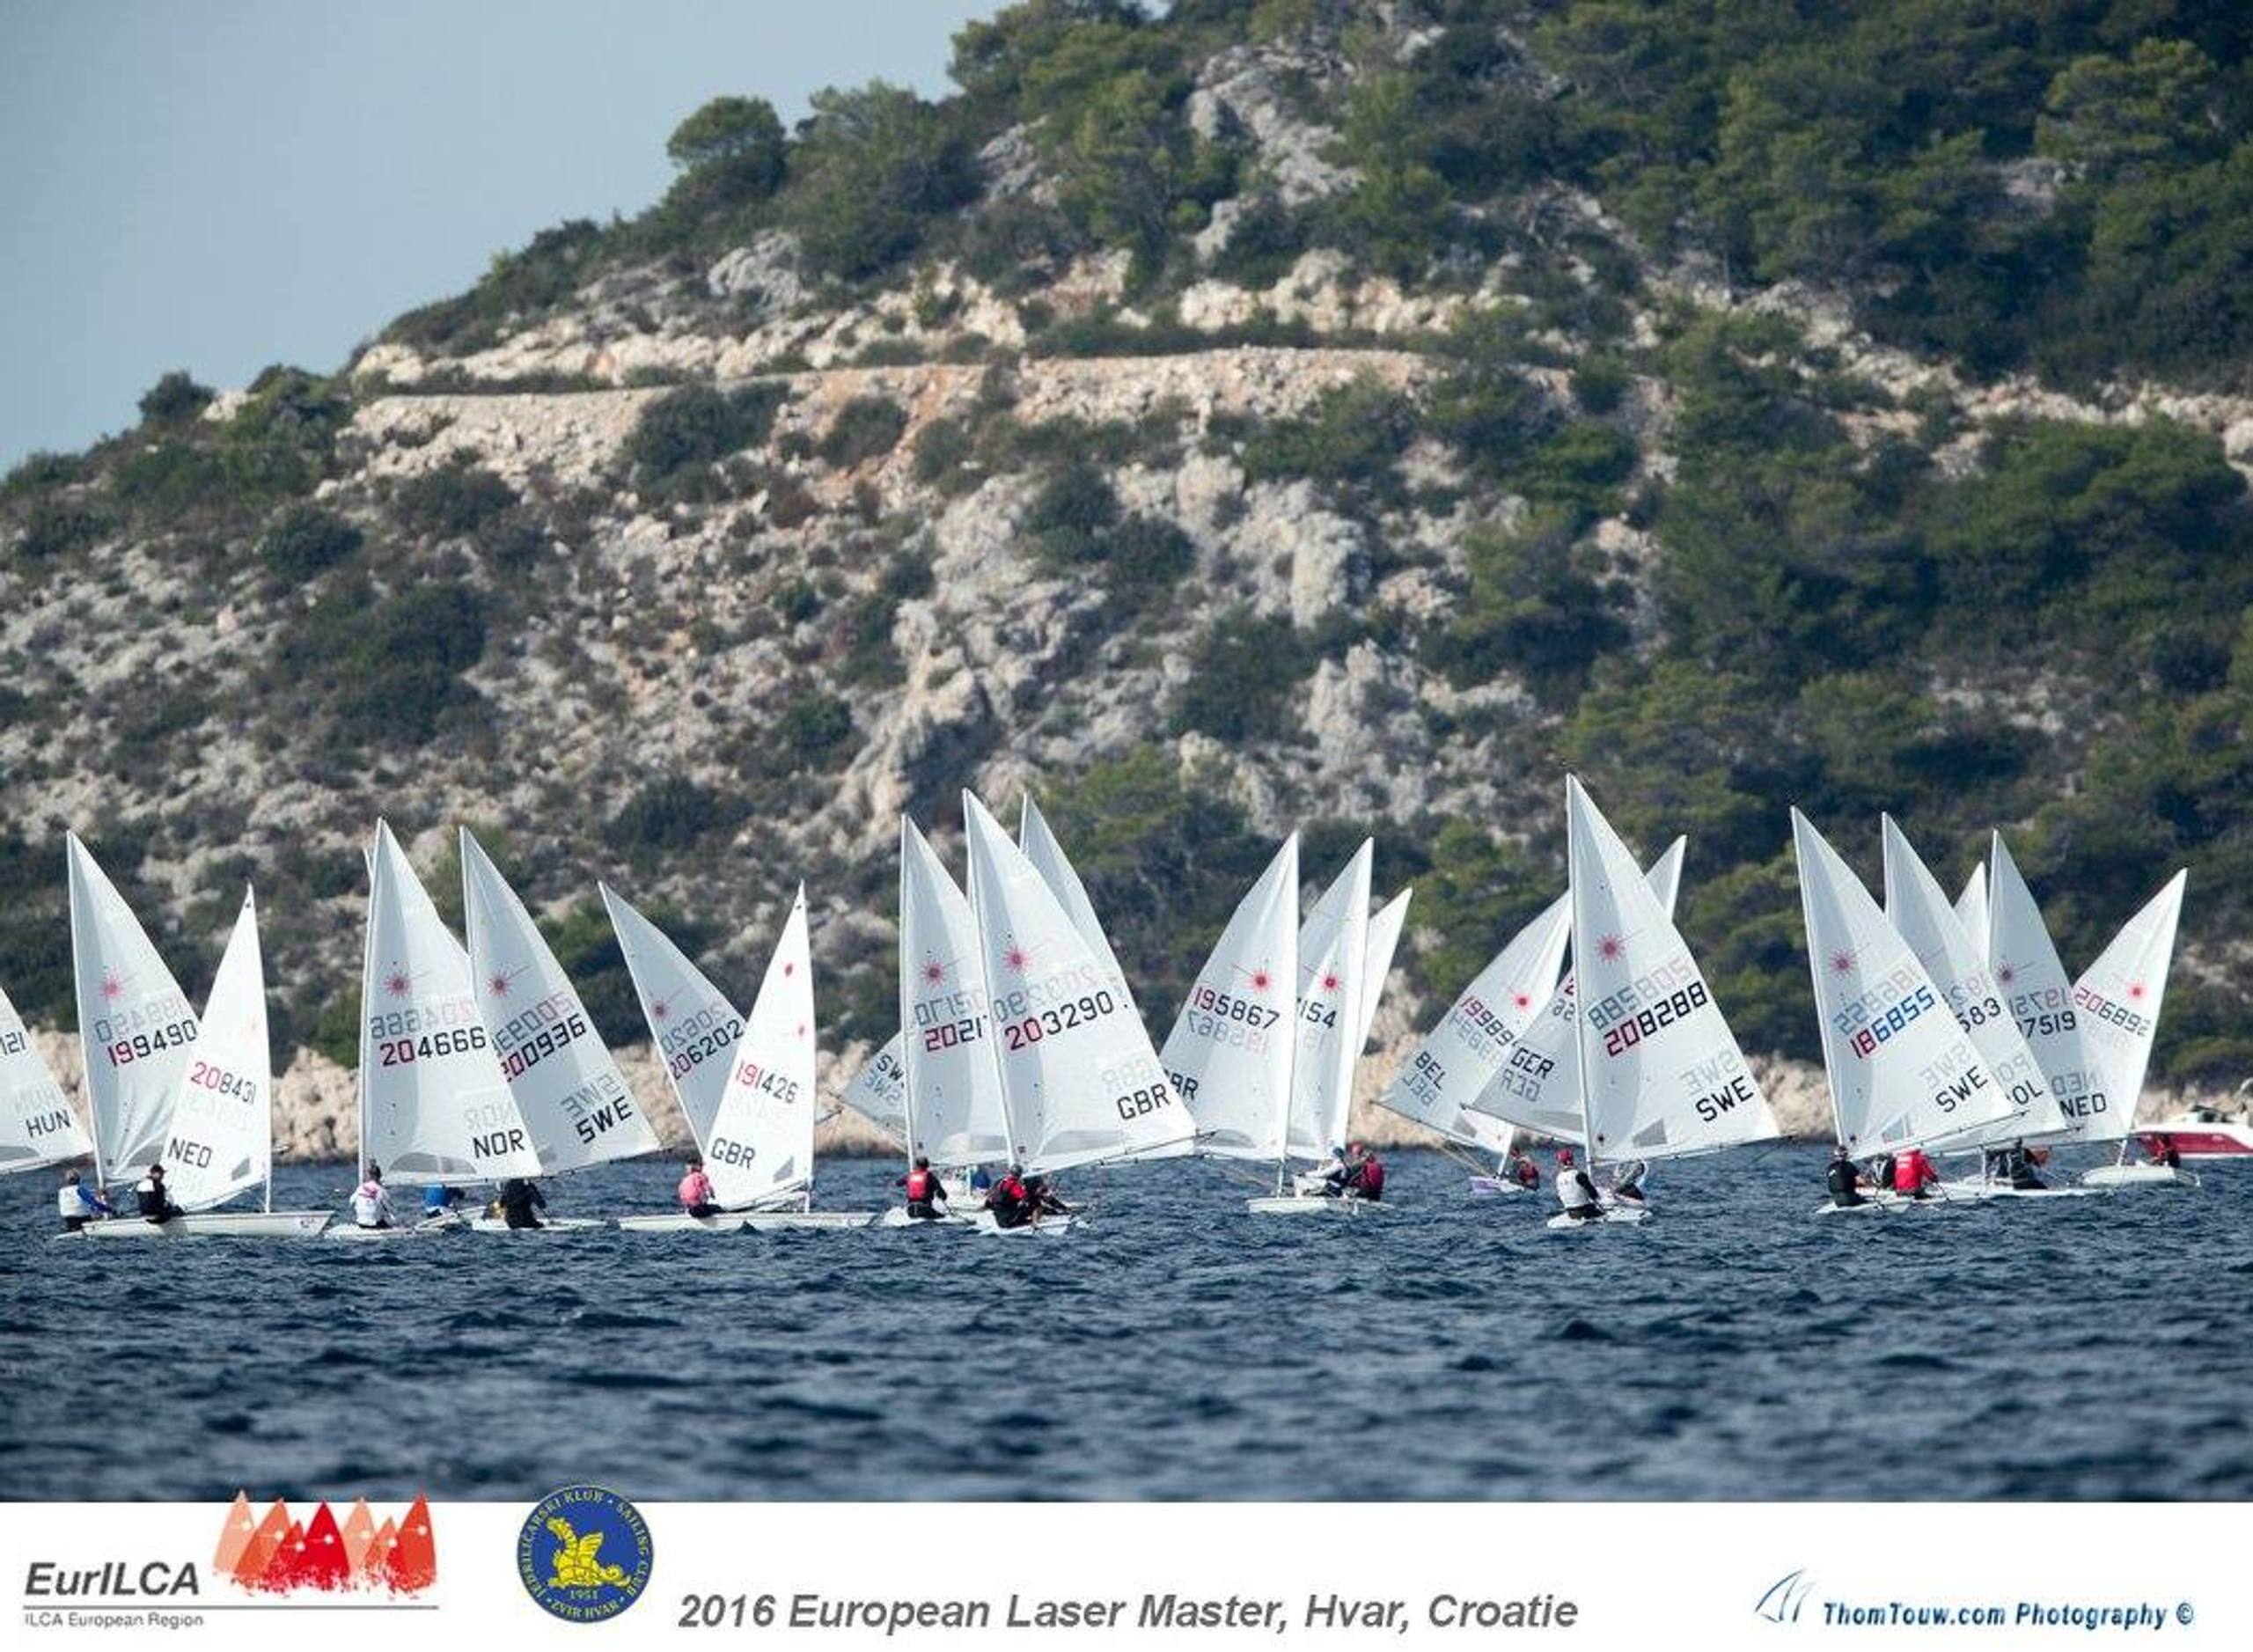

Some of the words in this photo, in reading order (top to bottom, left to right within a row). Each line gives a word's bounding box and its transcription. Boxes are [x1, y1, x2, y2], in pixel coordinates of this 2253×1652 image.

[1004, 990, 1114, 1051] 203290
[1193, 986, 1281, 1030] 195867
[1297, 997, 1337, 1029] 154
[1460, 995, 1519, 1047] 19989
[1603, 980, 1708, 1057] 208288
[1850, 985, 1935, 1060] 186855
[1941, 994, 2000, 1033] 583
[106, 1018, 198, 1068] 199490
[379, 1025, 487, 1068] 204666
[670, 1019, 745, 1081] 206202
[925, 1015, 987, 1052] 2021
[190, 1061, 257, 1105] 208431
[736, 1060, 799, 1104] 191426
[877, 1054, 905, 1089] SW
[1414, 1051, 1446, 1090] BEL
[1510, 1047, 1555, 1080] GER
[1116, 1083, 1171, 1120] GBR
[1163, 1068, 1198, 1100] BR
[1695, 1076, 1755, 1122] SWE
[1935, 1065, 1989, 1113] SWE
[2007, 1079, 2044, 1106] OL
[26, 1109, 71, 1138] HUN
[575, 1095, 633, 1144] SWE
[2059, 1092, 2106, 1119] NED
[168, 1138, 213, 1169] NED
[472, 1128, 525, 1159] NOR
[710, 1137, 756, 1169] GBR
